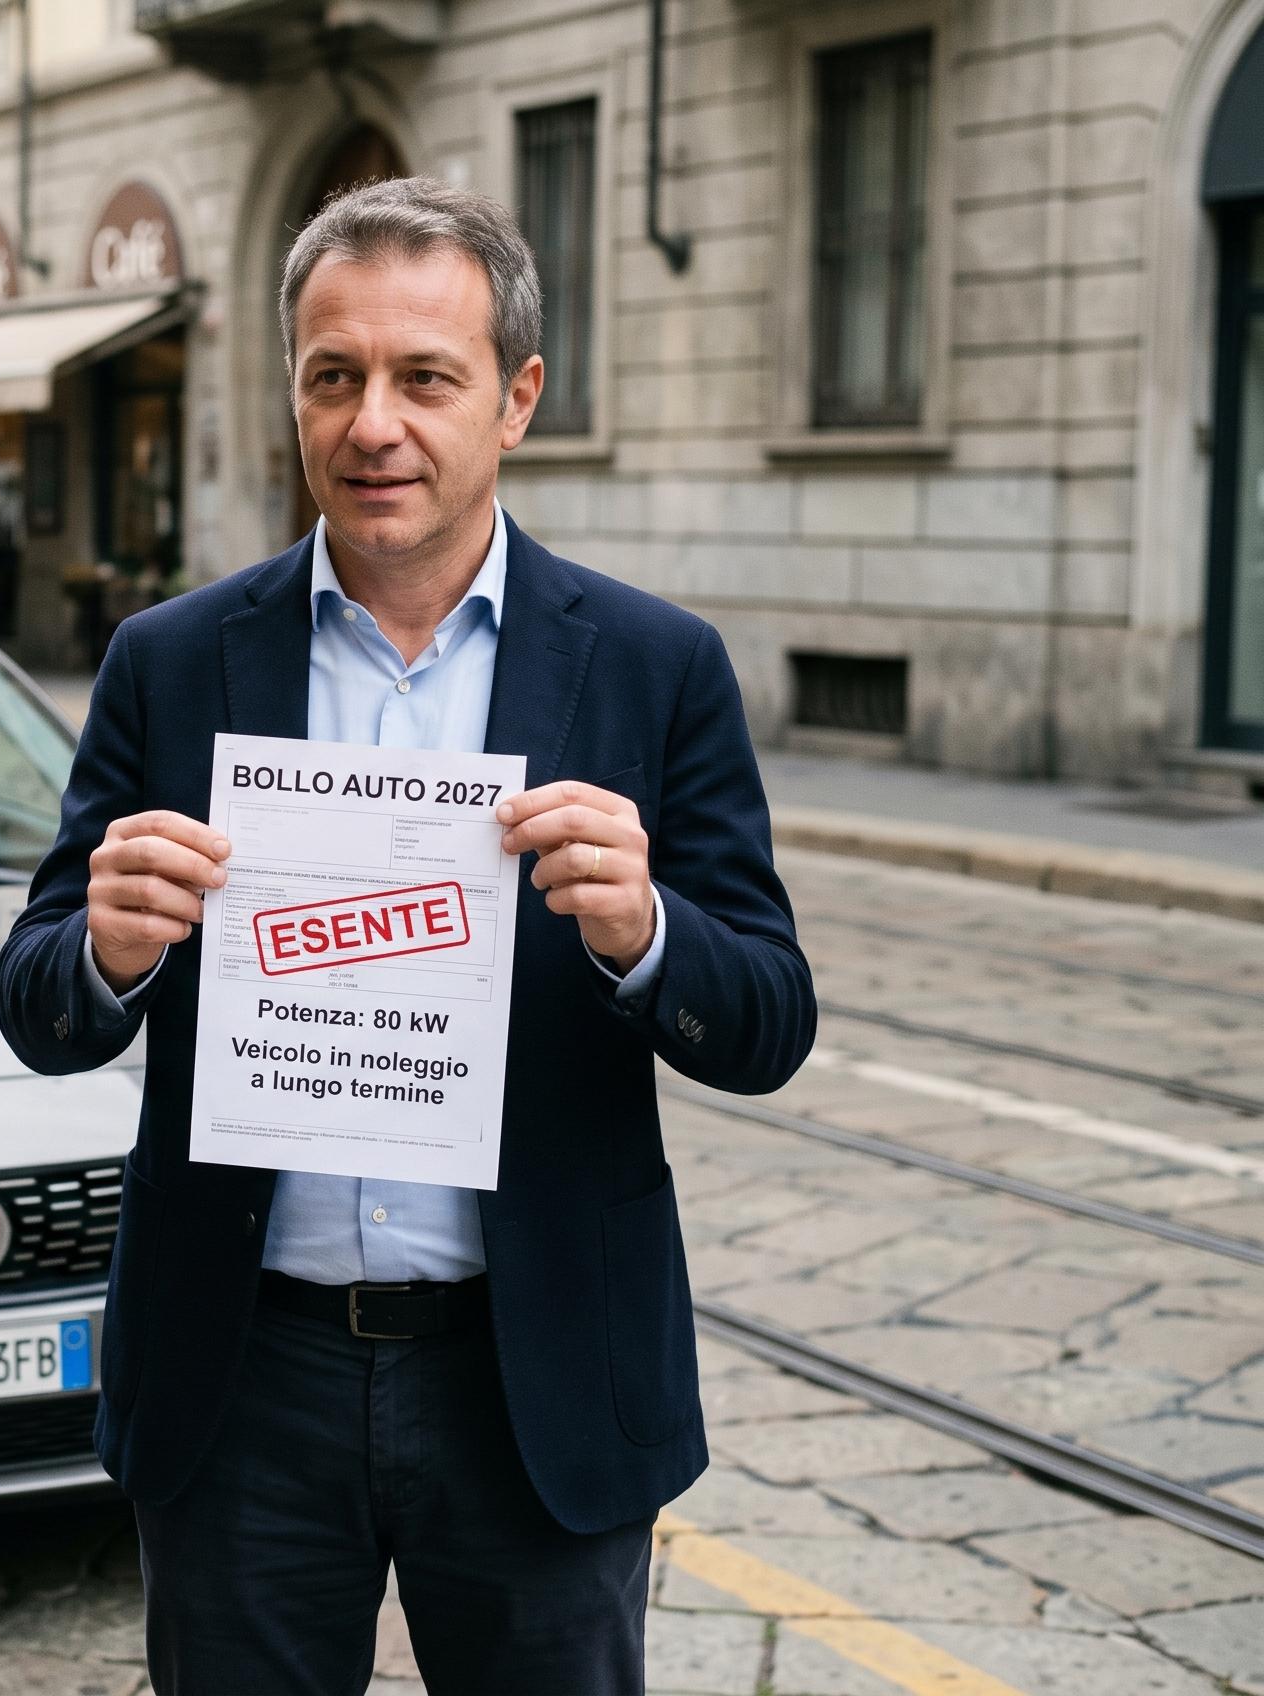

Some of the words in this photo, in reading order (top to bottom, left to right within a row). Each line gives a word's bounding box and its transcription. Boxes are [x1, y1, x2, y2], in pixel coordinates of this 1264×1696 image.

[232, 764, 334, 795] BOLLO
[341, 774, 426, 802] AUTO
[434, 780, 503, 807] 2027
[270, 897, 454, 959] ESENTE
[258, 998, 364, 1027] Potenza:
[373, 1008, 402, 1031] 80
[410, 1011, 450, 1034] kW
[231, 1037, 322, 1064] Veicolo
[330, 1046, 351, 1067] in
[360, 1051, 469, 1081] noleggio
[250, 1073, 264, 1089] a
[273, 1070, 343, 1099] lungo
[350, 1078, 444, 1105] termine
